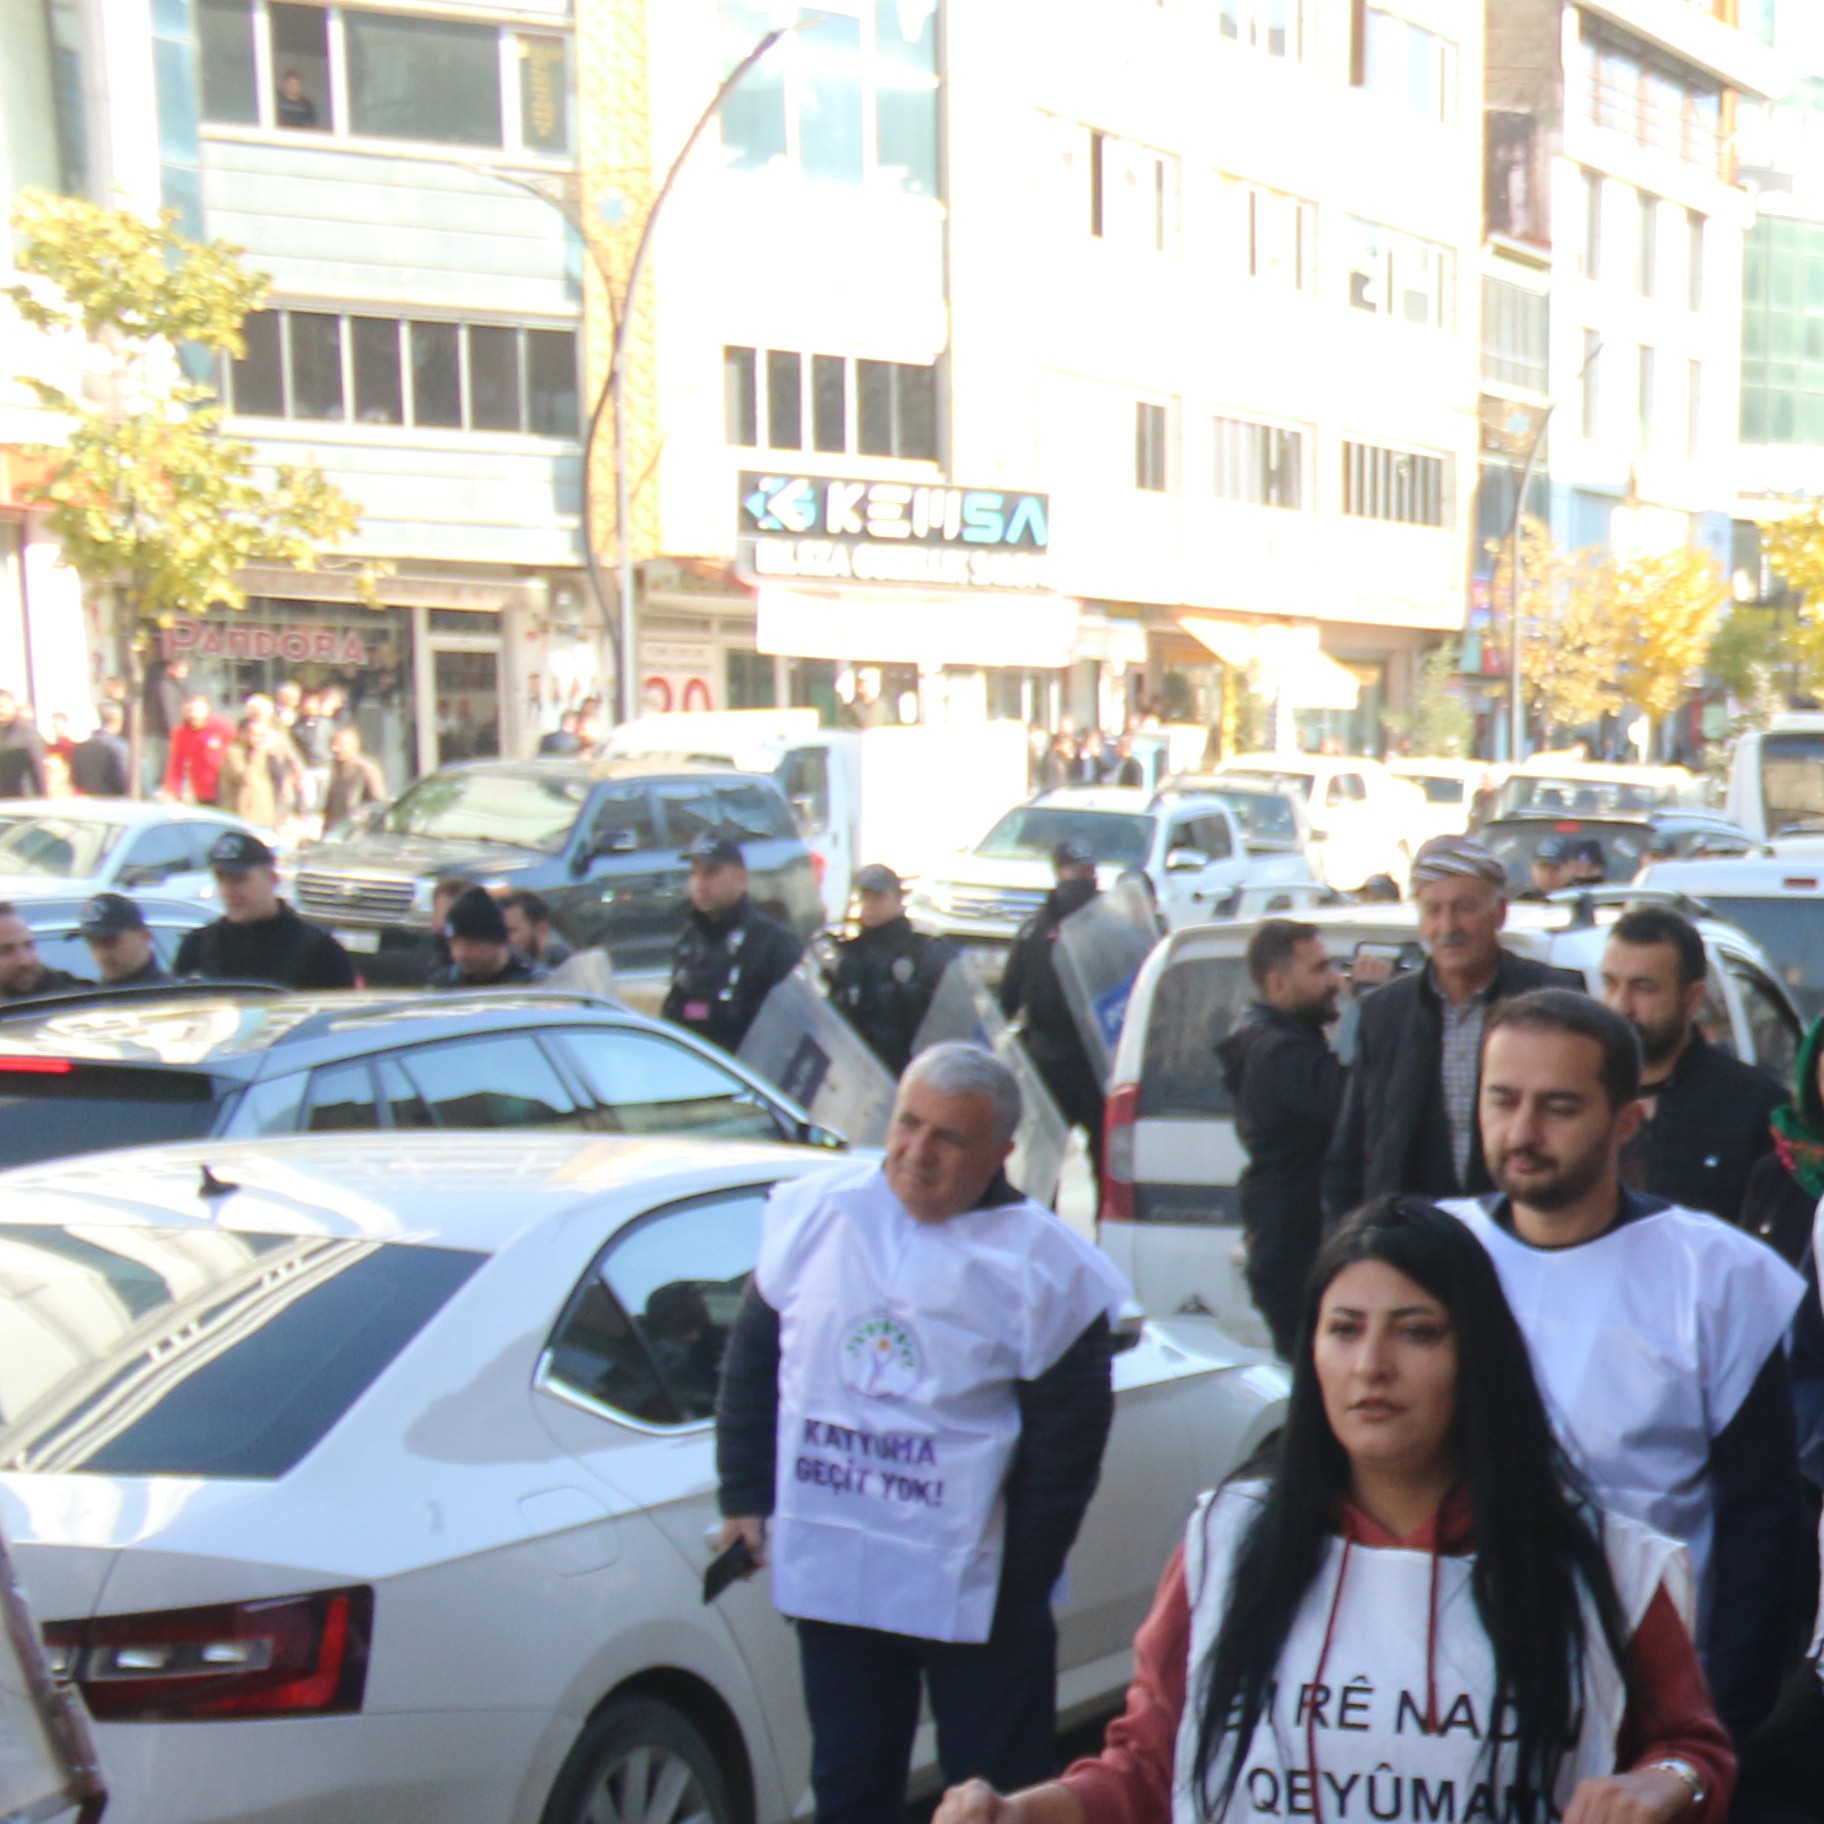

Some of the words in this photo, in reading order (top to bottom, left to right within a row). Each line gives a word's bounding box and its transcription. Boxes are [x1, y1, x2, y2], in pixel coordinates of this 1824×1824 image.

[826, 482, 1048, 546] KEMSA
[161, 616, 369, 666] PANDORA
[796, 1455, 870, 1497] GEÇİT
[880, 1471, 944, 1507] YOK!
[1294, 1674, 1375, 1732] RÊ
